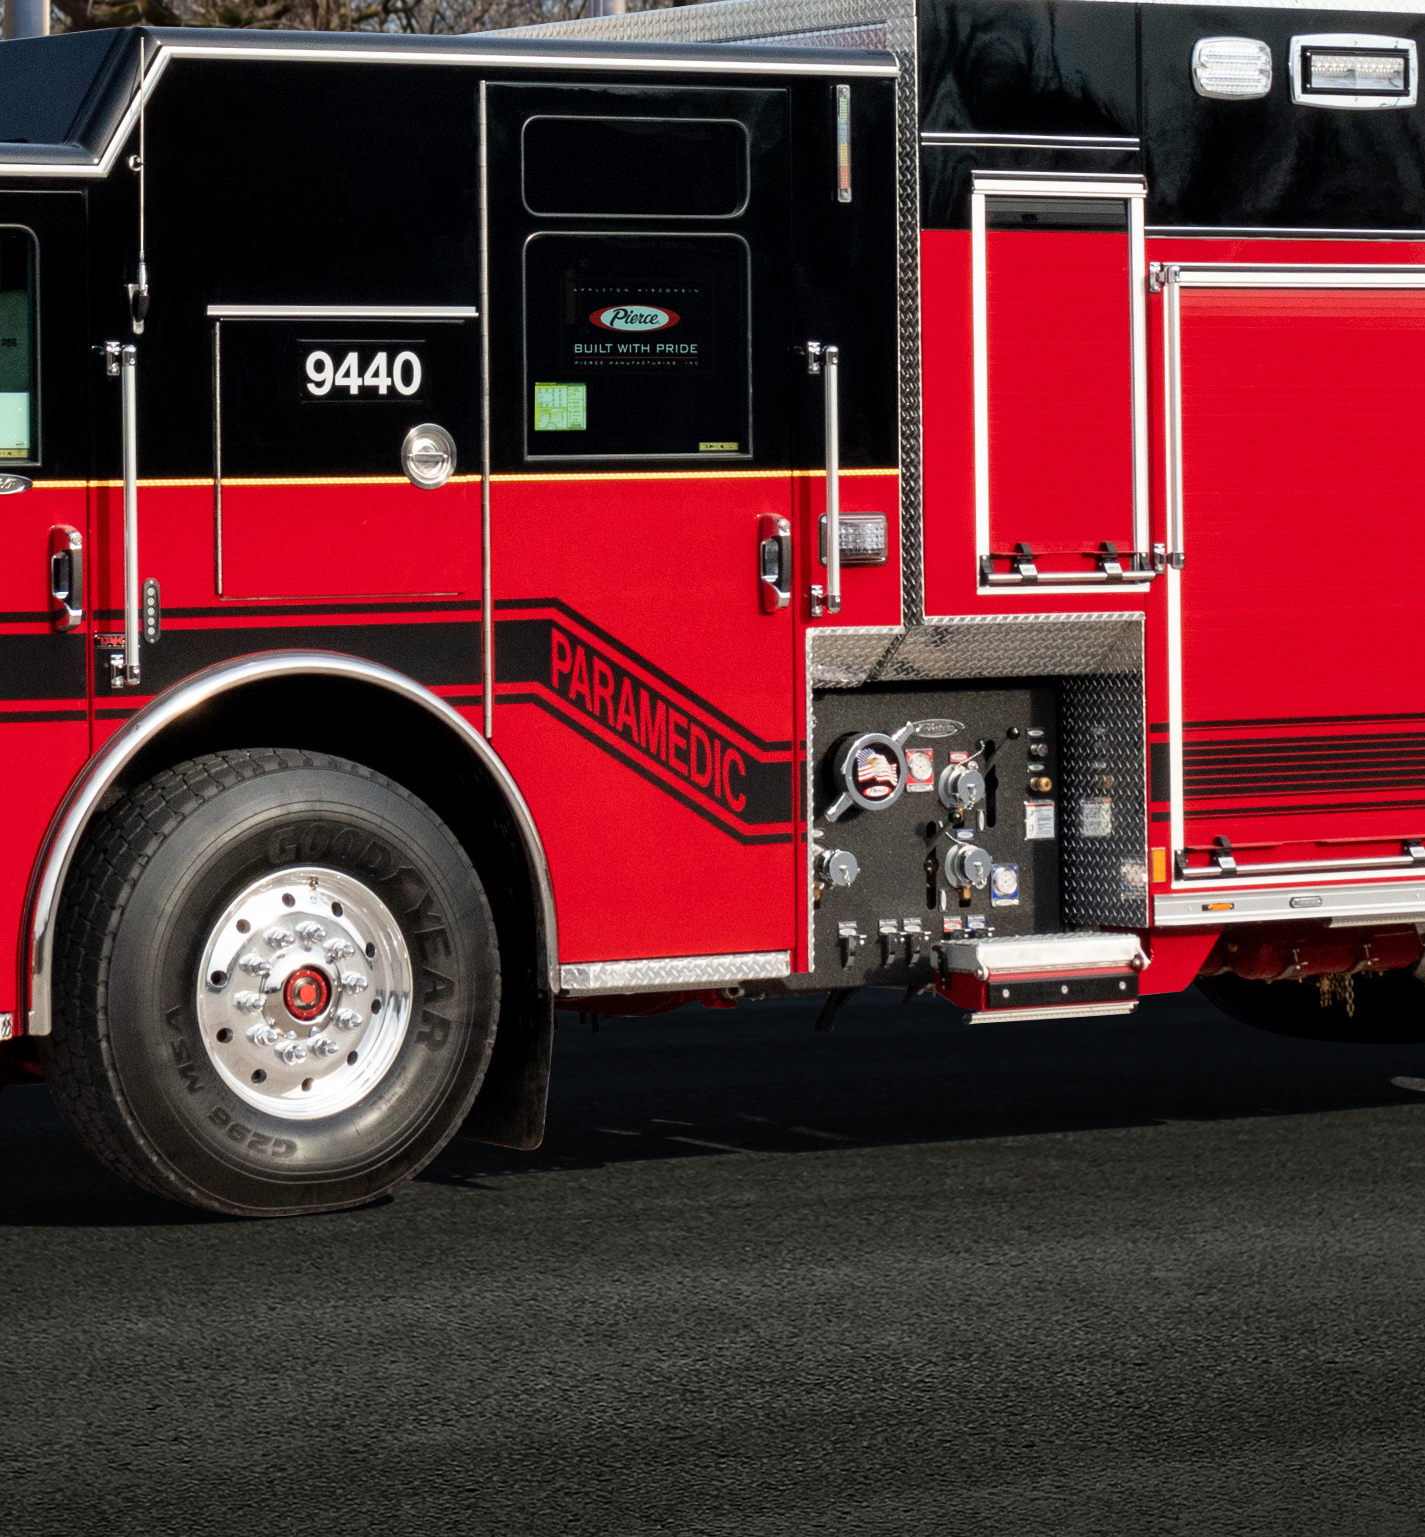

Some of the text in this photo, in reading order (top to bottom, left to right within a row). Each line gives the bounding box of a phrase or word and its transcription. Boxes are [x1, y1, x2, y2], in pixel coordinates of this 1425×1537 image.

[609, 307, 660, 327] Pierce
[574, 343, 698, 353] BUILT WITH PRIDE
[305, 350, 422, 396] 9440
[551, 627, 747, 813] PARAMEDIC
[207, 1106, 298, 1159] G296
